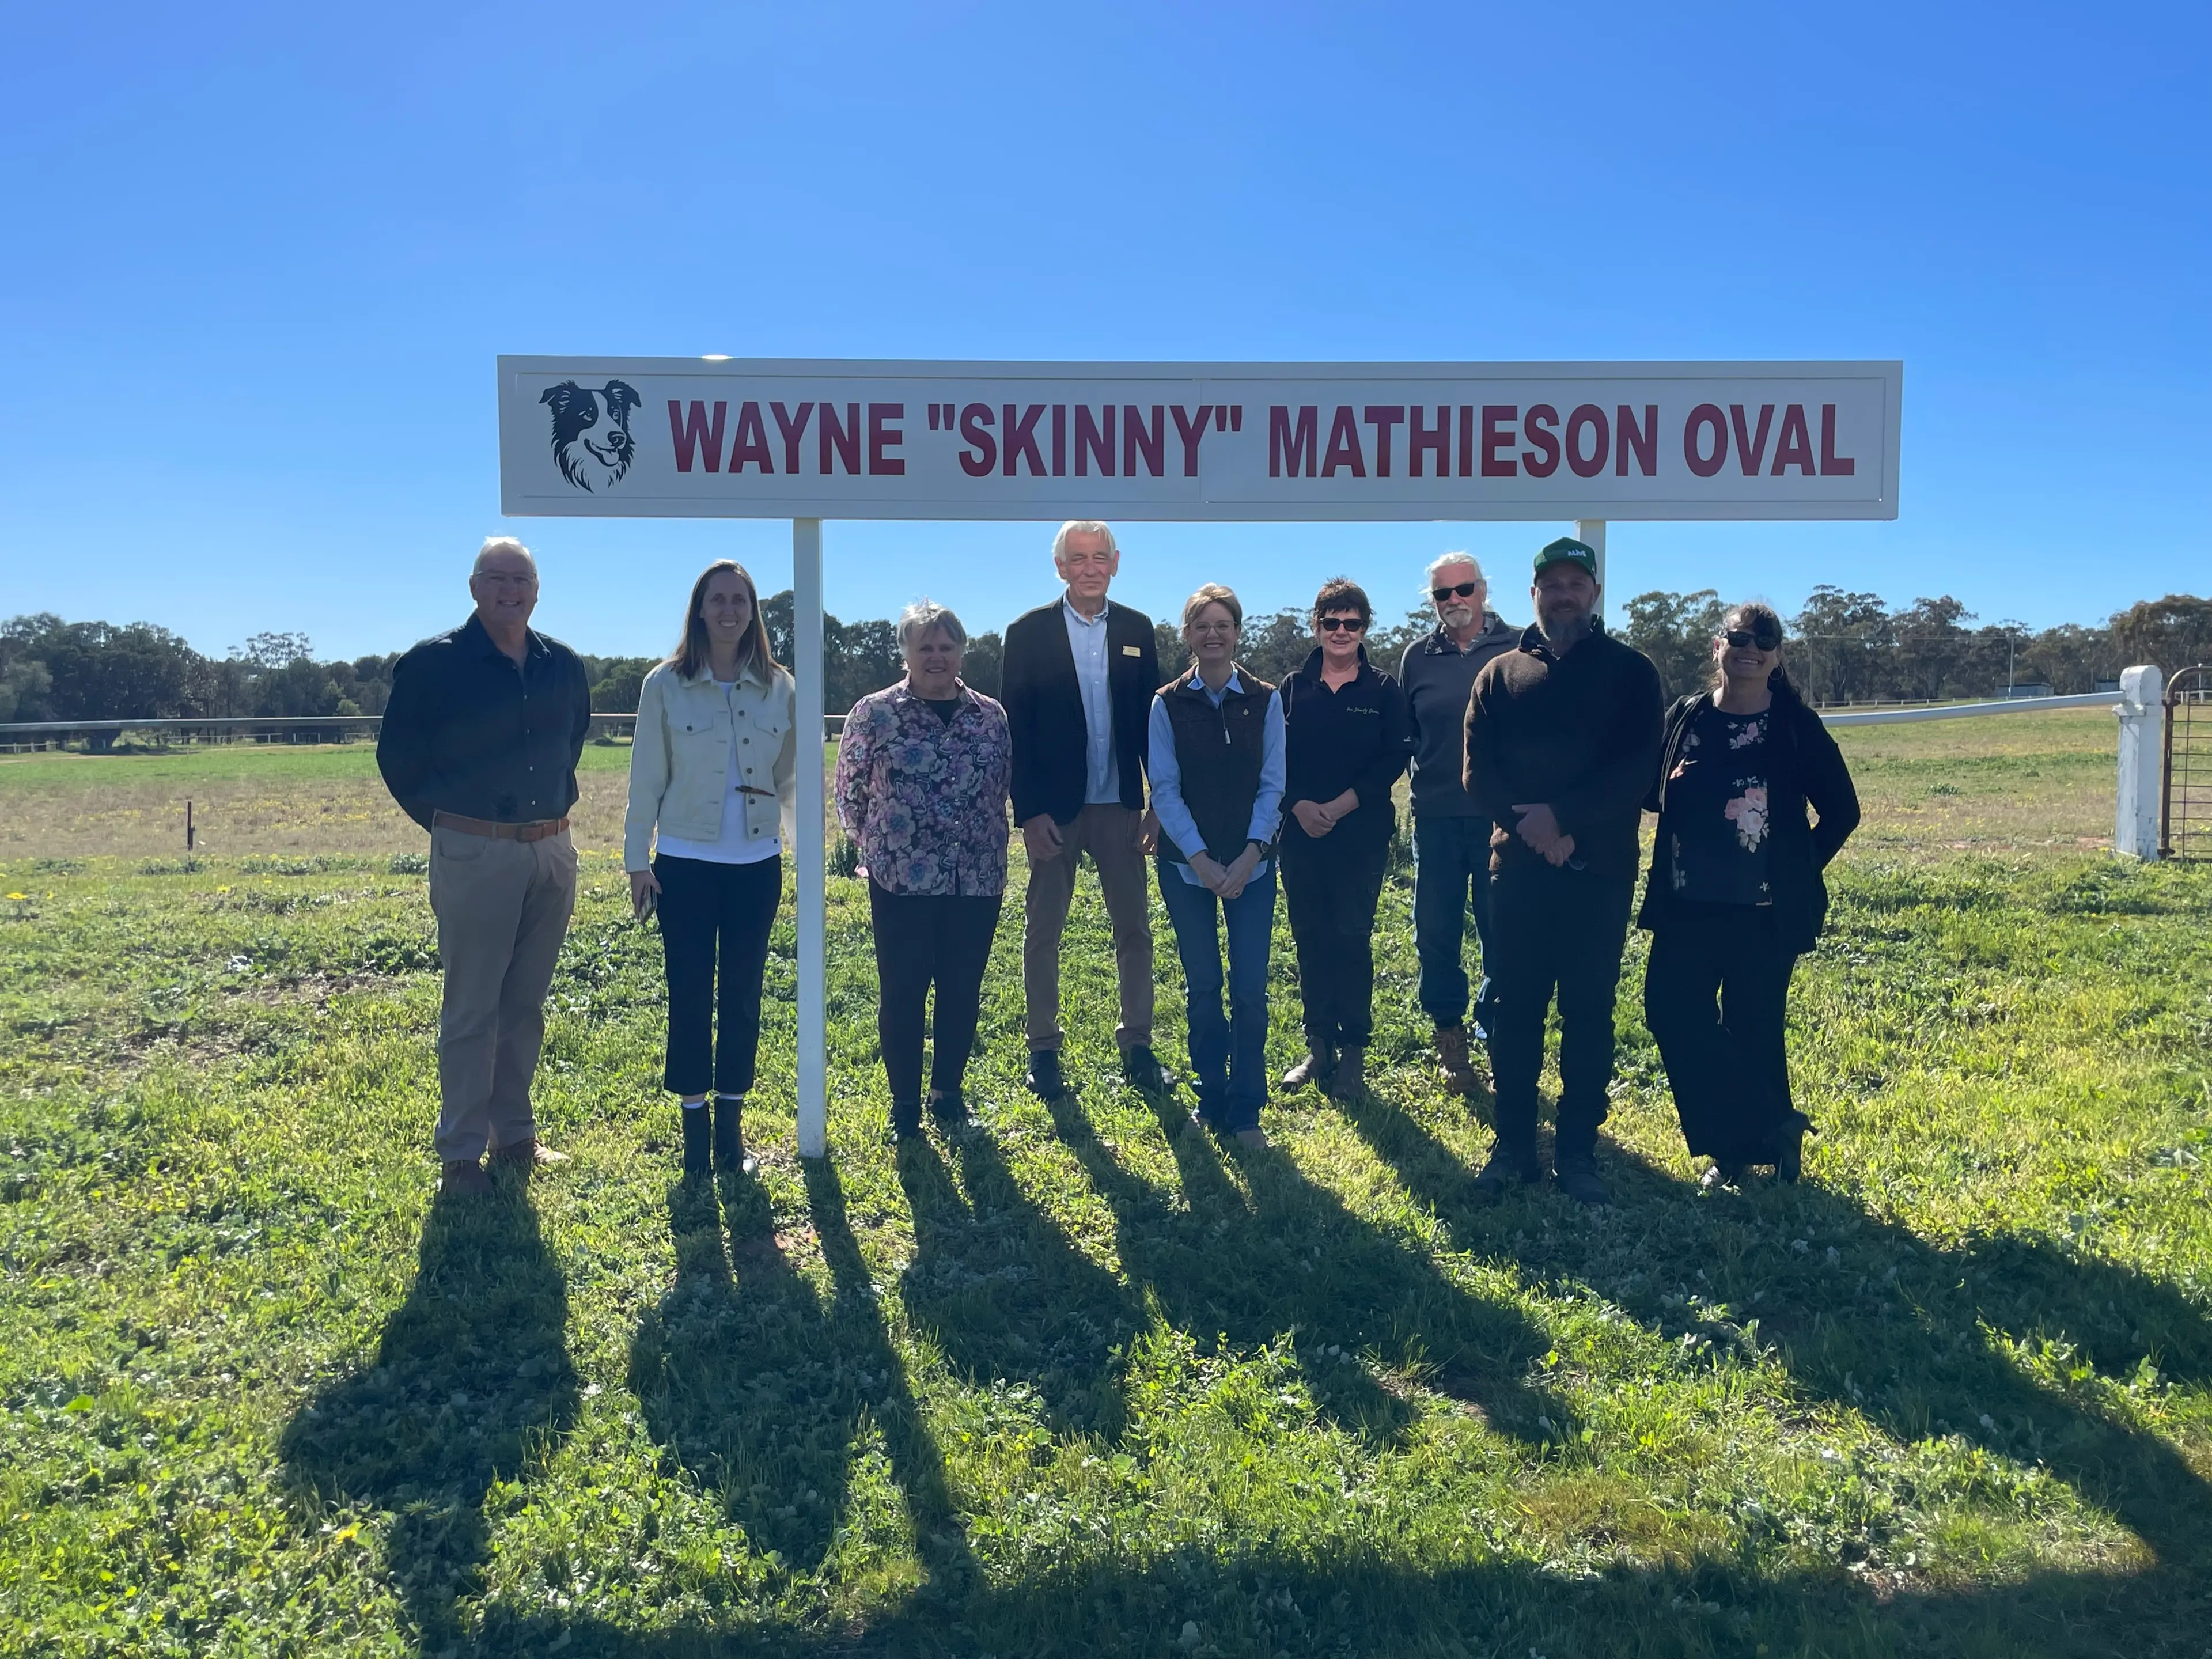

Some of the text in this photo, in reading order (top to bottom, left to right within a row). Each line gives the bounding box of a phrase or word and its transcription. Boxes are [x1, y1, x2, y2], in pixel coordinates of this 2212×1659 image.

[667, 400, 1855, 478] WAYNE "SKINNY" MATHIESON OVAL
